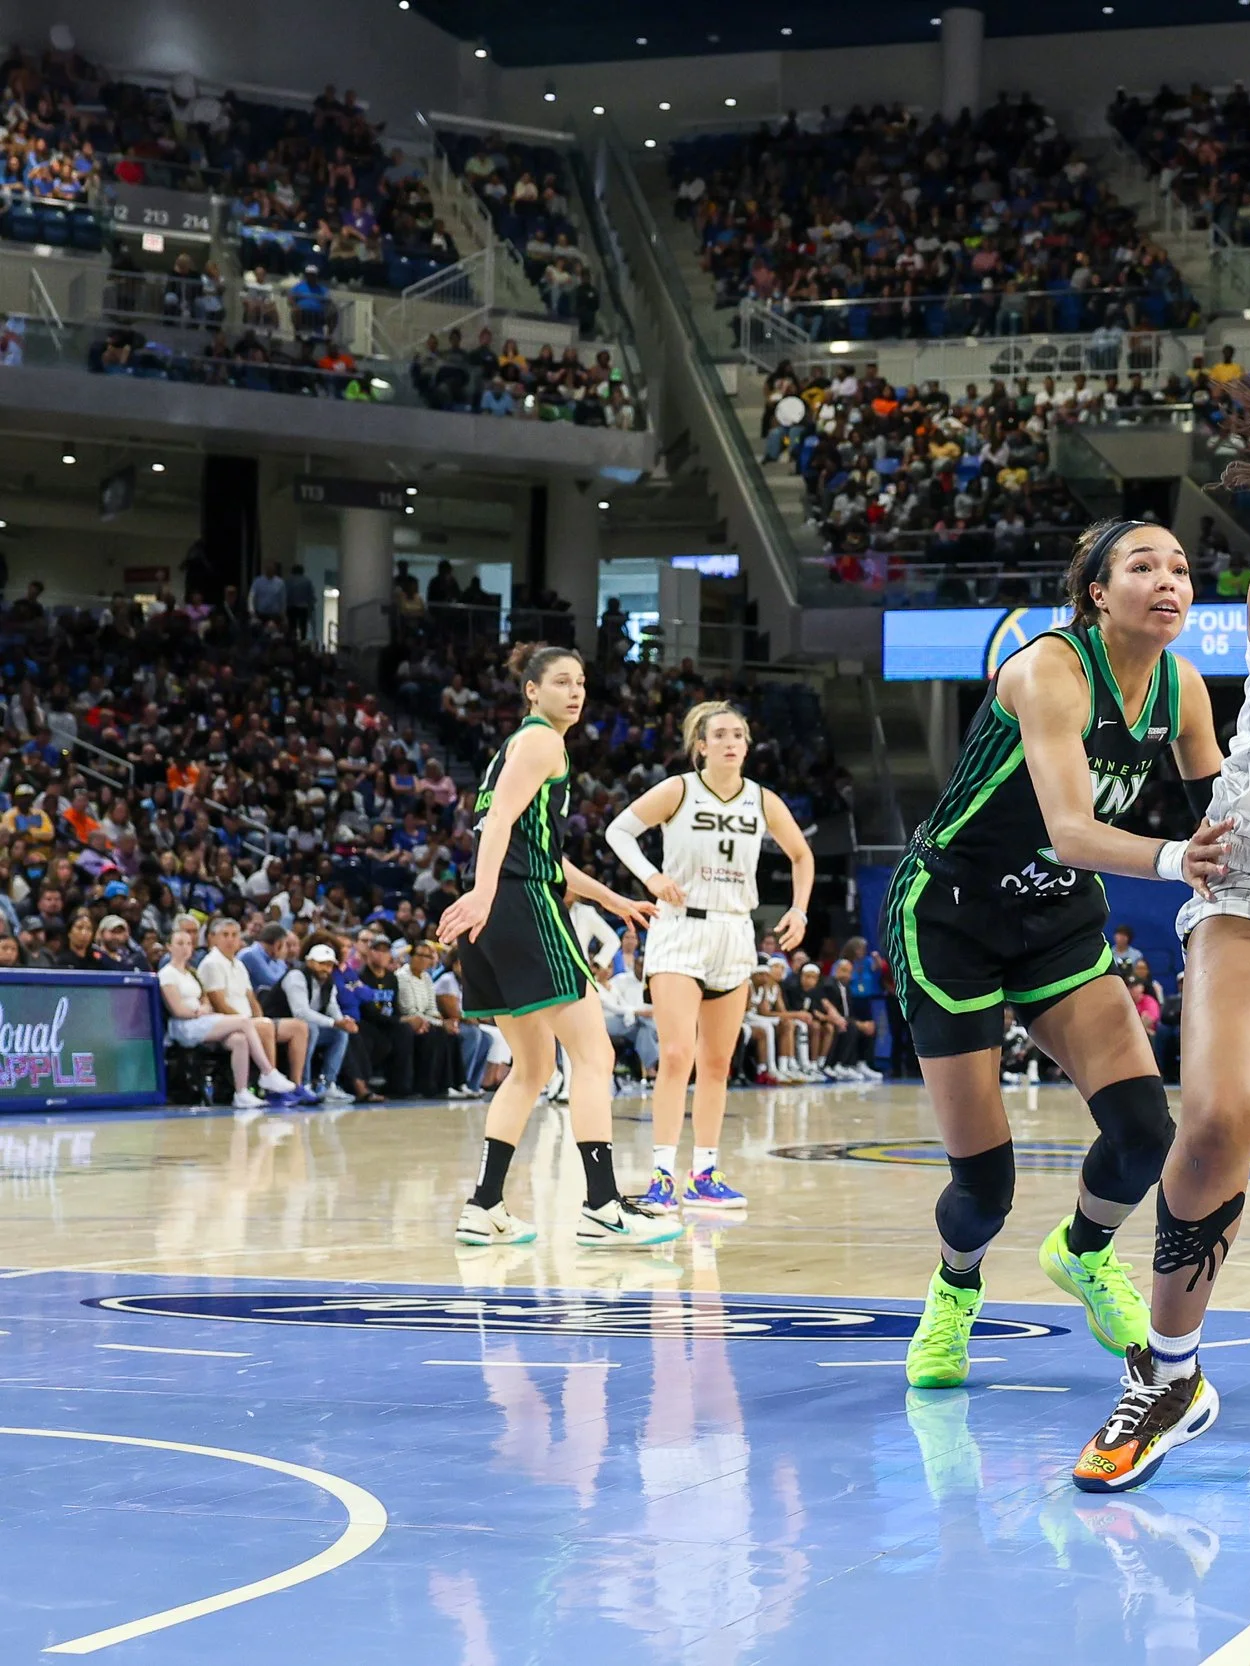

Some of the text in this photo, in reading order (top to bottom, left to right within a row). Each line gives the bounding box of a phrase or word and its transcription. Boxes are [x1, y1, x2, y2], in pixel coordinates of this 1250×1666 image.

[1185, 611, 1247, 632] FOUL
[1202, 633, 1229, 655] 05
[691, 811, 757, 836] SKY
[718, 839, 734, 862] 4
